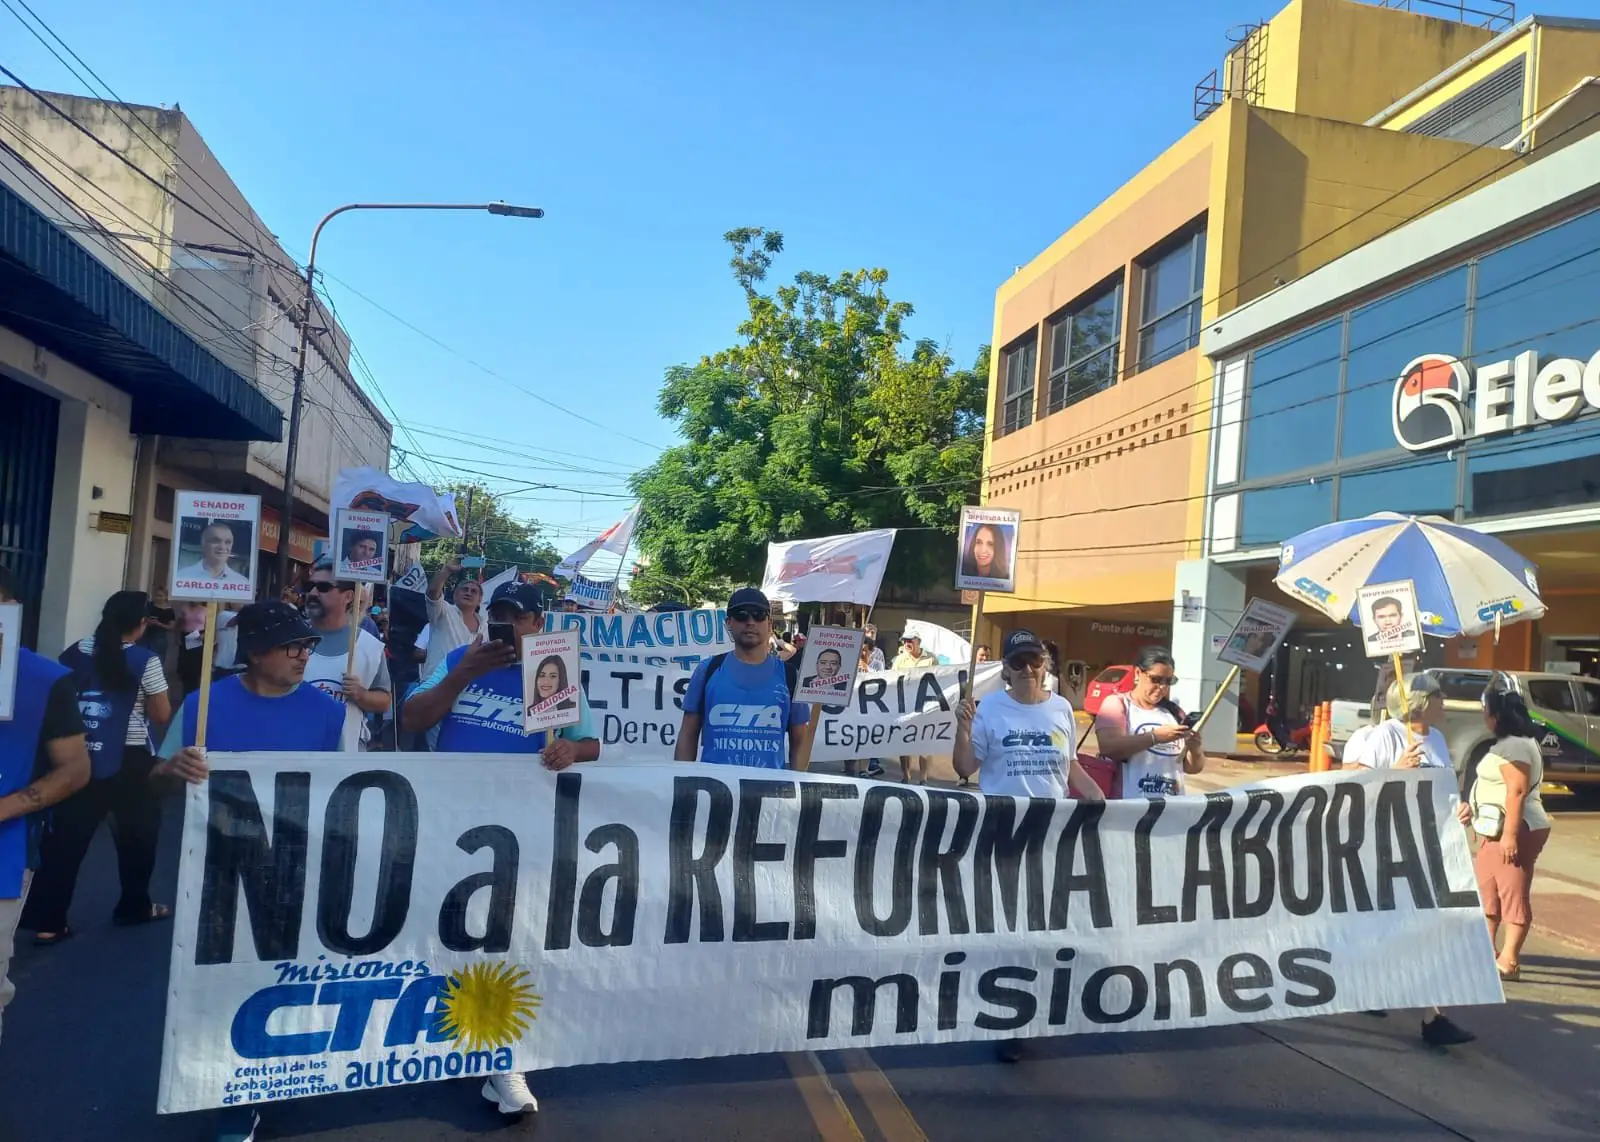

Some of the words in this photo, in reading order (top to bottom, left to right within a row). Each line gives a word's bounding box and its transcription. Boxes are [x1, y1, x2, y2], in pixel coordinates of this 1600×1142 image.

[193, 500, 245, 511] SENADOR
[348, 515, 381, 523] SENADOR
[348, 556, 384, 568] TRAIDOR
[176, 580, 219, 590] CARLOS
[222, 583, 251, 591] ARCE
[819, 632, 853, 640] DIPUTADO
[1091, 622, 1121, 633] Punto
[1122, 624, 1135, 634] de
[1136, 626, 1168, 638] Carga
[535, 638, 566, 647] DIPUTADA
[814, 640, 855, 648] RENOVADOR
[530, 646, 572, 656] RENOVADORA
[810, 673, 851, 688] TRAIDOR
[531, 685, 577, 715] TRAIDORA
[708, 703, 783, 729] CTA
[713, 737, 780, 753] MISIONES
[1002, 734, 1053, 747] CTA
[194, 769, 419, 966] NO
[438, 823, 520, 954] a
[544, 772, 640, 951] la
[664, 776, 1113, 945] REFORMA
[1134, 780, 1479, 926] LABORAL
[273, 955, 432, 984] misiones
[807, 947, 1337, 1040] misiones
[230, 975, 464, 1060] CTA
[234, 1063, 289, 1078] central
[292, 1060, 305, 1072] de
[309, 1060, 328, 1071] los
[345, 1046, 513, 1089] autónoma
[223, 1072, 325, 1093] trabajadores
[222, 1093, 242, 1105] de
[248, 1090, 262, 1102] la
[267, 1083, 339, 1102] argentina
